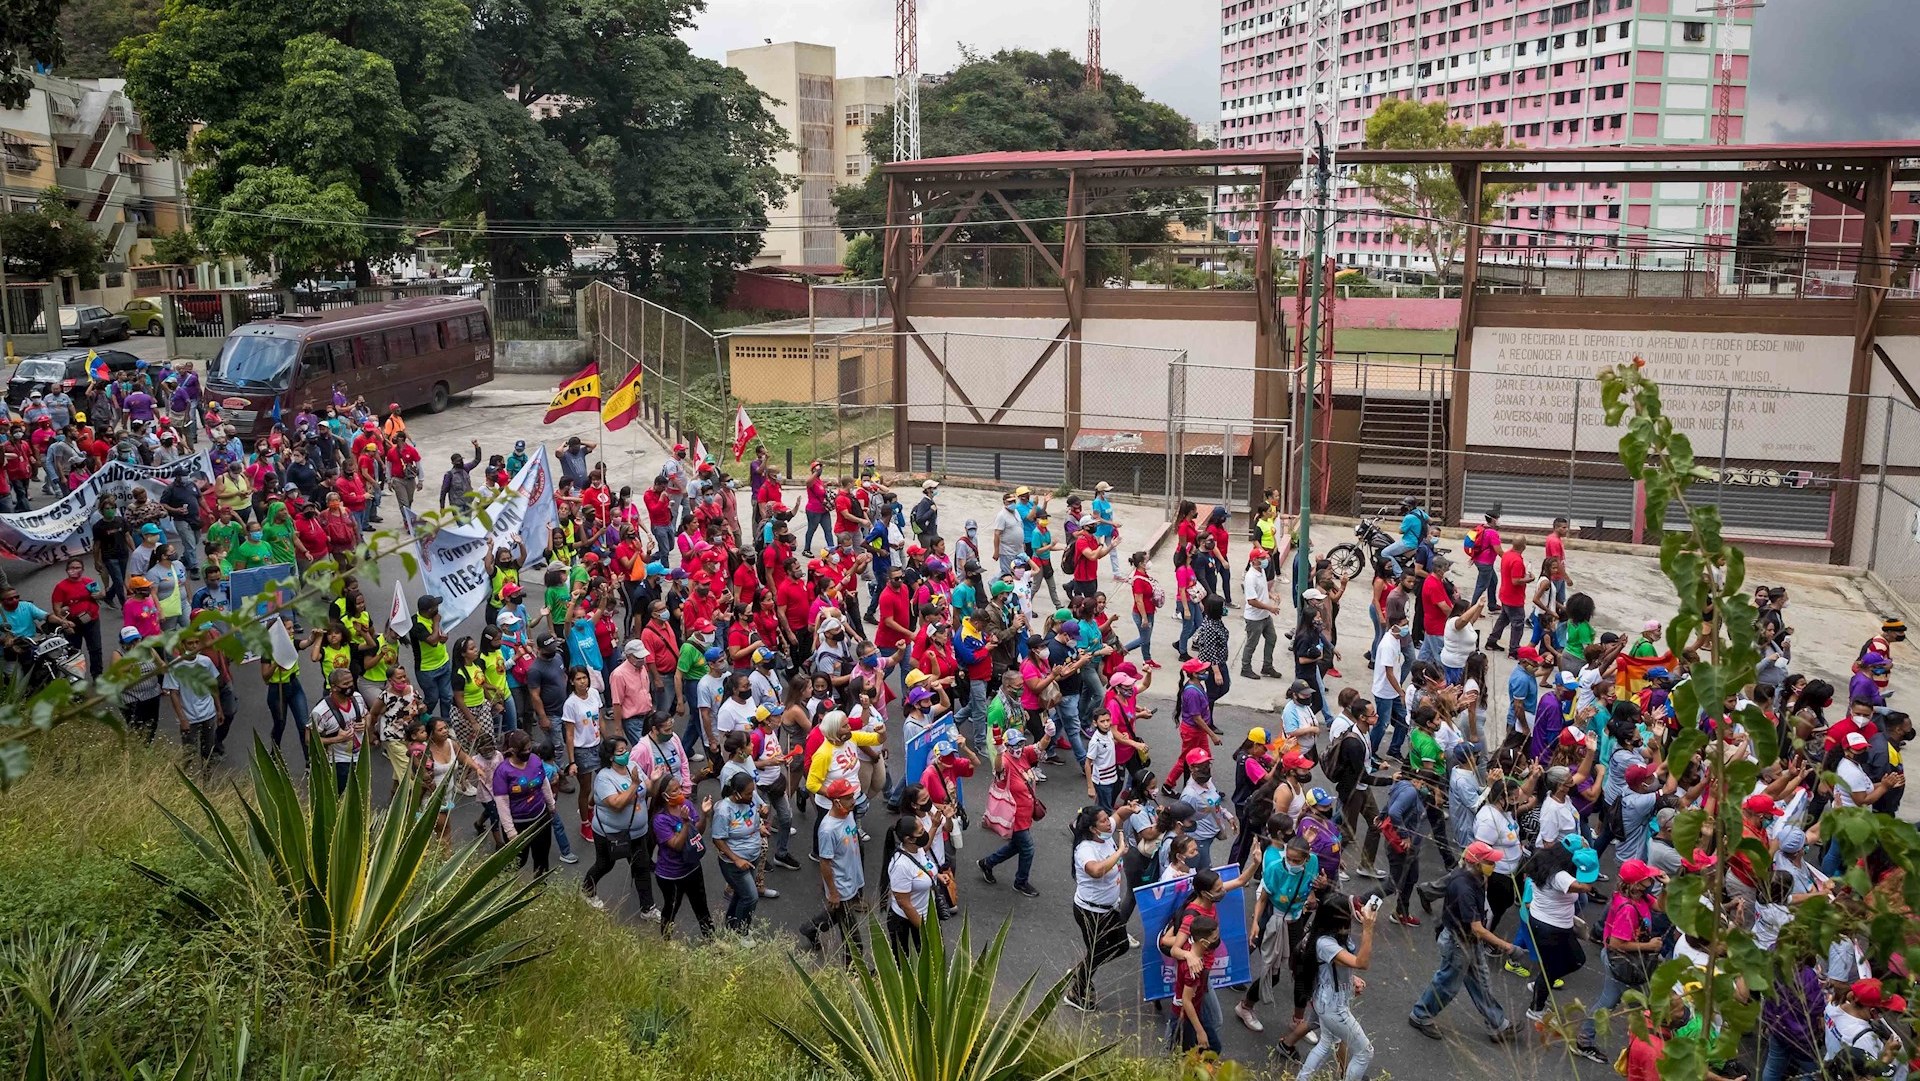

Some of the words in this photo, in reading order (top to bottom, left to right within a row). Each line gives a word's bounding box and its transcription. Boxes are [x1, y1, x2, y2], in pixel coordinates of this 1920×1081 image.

[1521, 333, 1566, 346] RECUERDA
[1569, 335, 1580, 346] EL
[1647, 337, 1689, 350] APRENDÍ
[1692, 340, 1698, 350] A
[1702, 339, 1742, 350] PERDER
[1746, 340, 1779, 352] DESDE
[1783, 339, 1805, 353] NIÑO
[1498, 349, 1505, 360] A
[1509, 348, 1562, 361] RECONOCER
[1566, 350, 1573, 361] A
[1576, 351, 1589, 362] UN
[1648, 352, 1683, 365] CUANDO
[1687, 354, 1700, 365] NO
[1704, 354, 1730, 367] PUDE
[1735, 355, 1742, 366] Y
[1496, 363, 1510, 374] ME
[1514, 362, 1538, 375] SACÓ
[1541, 365, 1553, 376] LA
[1557, 365, 1592, 377] PELOTA
[1653, 369, 1659, 380] A
[1677, 369, 1692, 381] ME
[1496, 379, 1526, 391] DARLE
[1530, 380, 1543, 391] LA
[1495, 394, 1525, 406] GANAR
[1529, 395, 1536, 406] Y
[1540, 396, 1546, 406] A
[1551, 396, 1569, 407] SER
[1692, 401, 1698, 411] Y
[1701, 401, 1744, 413] ASPIAR
[1749, 402, 1756, 413] A
[1762, 402, 1775, 414] UN
[1494, 411, 1552, 424] ADVERSARIO
[1558, 413, 1575, 425] QUE
[1671, 417, 1695, 430] ONOR
[440, 563, 484, 598] TRES
[44, 640, 61, 650] TAXI
